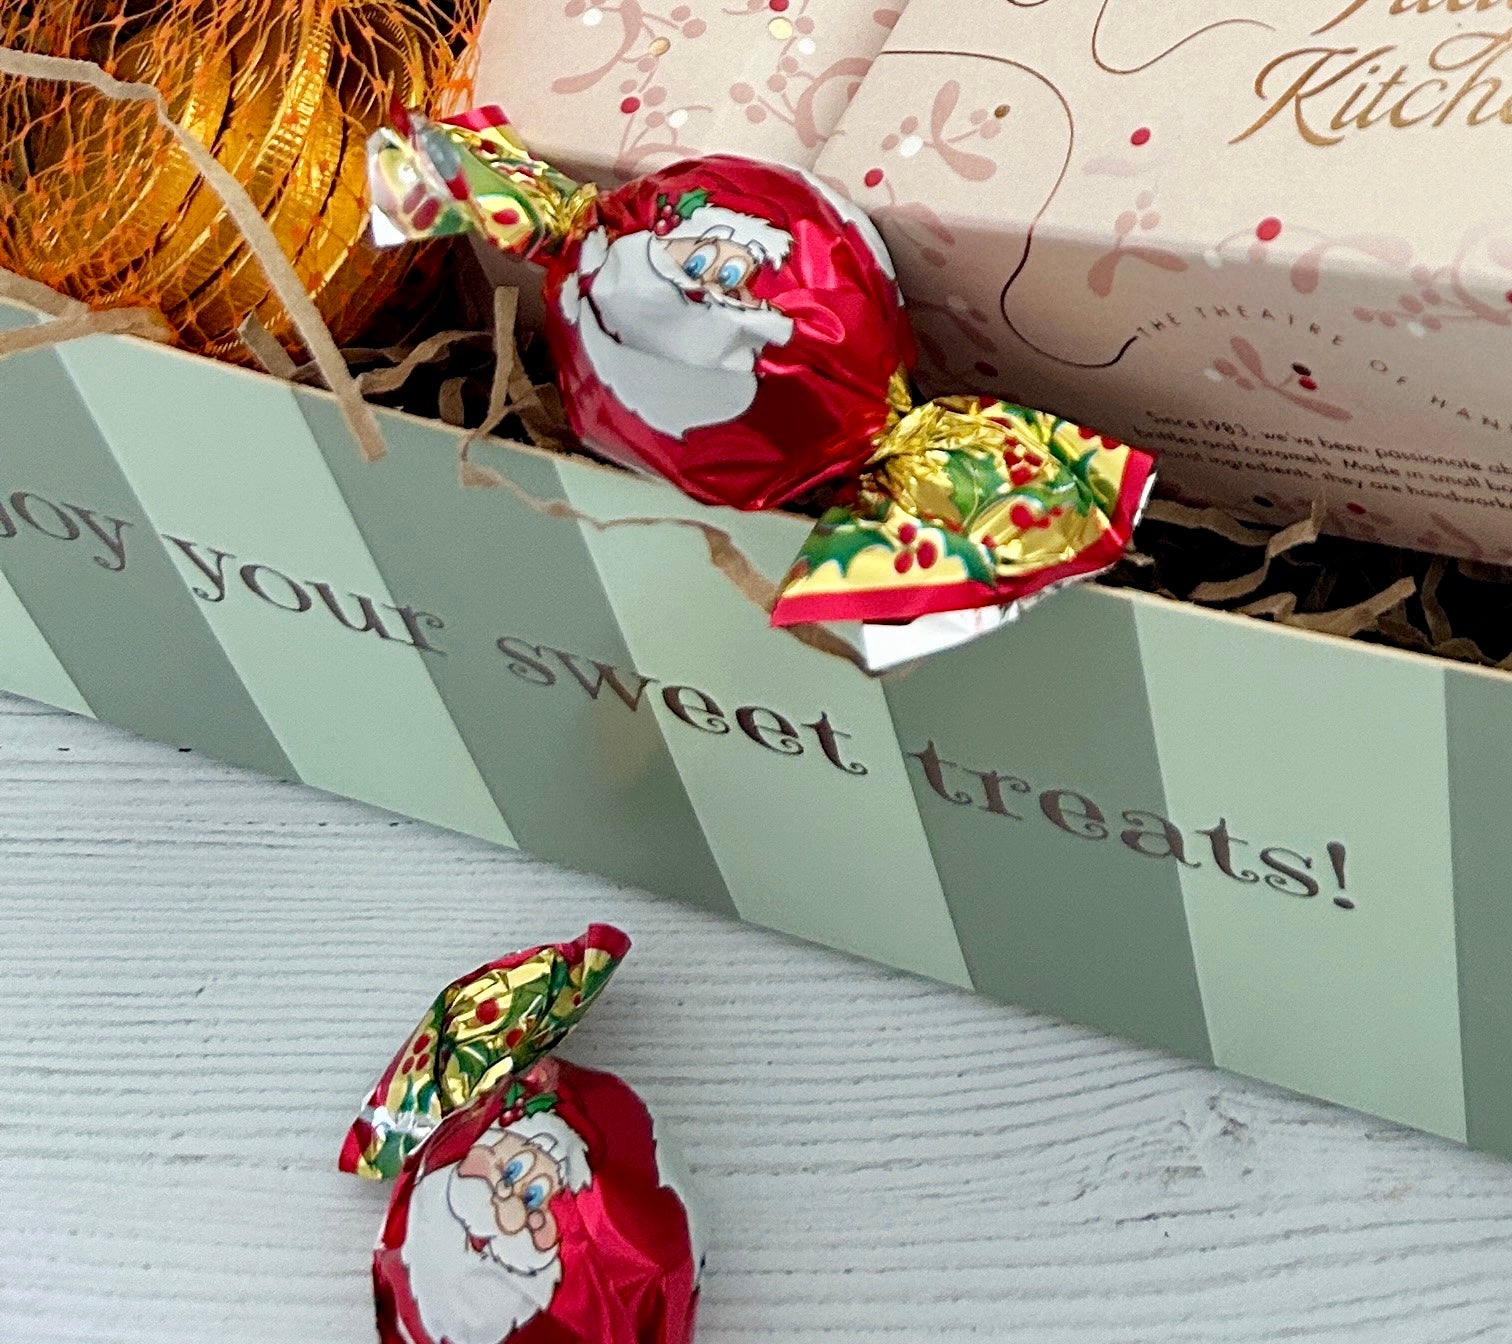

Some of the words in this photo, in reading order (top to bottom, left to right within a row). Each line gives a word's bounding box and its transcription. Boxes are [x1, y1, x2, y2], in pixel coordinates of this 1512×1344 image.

[1136, 312, 1181, 338] THE
[1202, 434, 1240, 454] and
[1342, 457, 1400, 478] Made
[1429, 471, 1481, 489] small
[1321, 469, 1363, 490] they
[1369, 478, 1402, 494] are
[161, 533, 447, 656] your
[495, 634, 870, 777] sweet
[908, 737, 1357, 911] treats!
